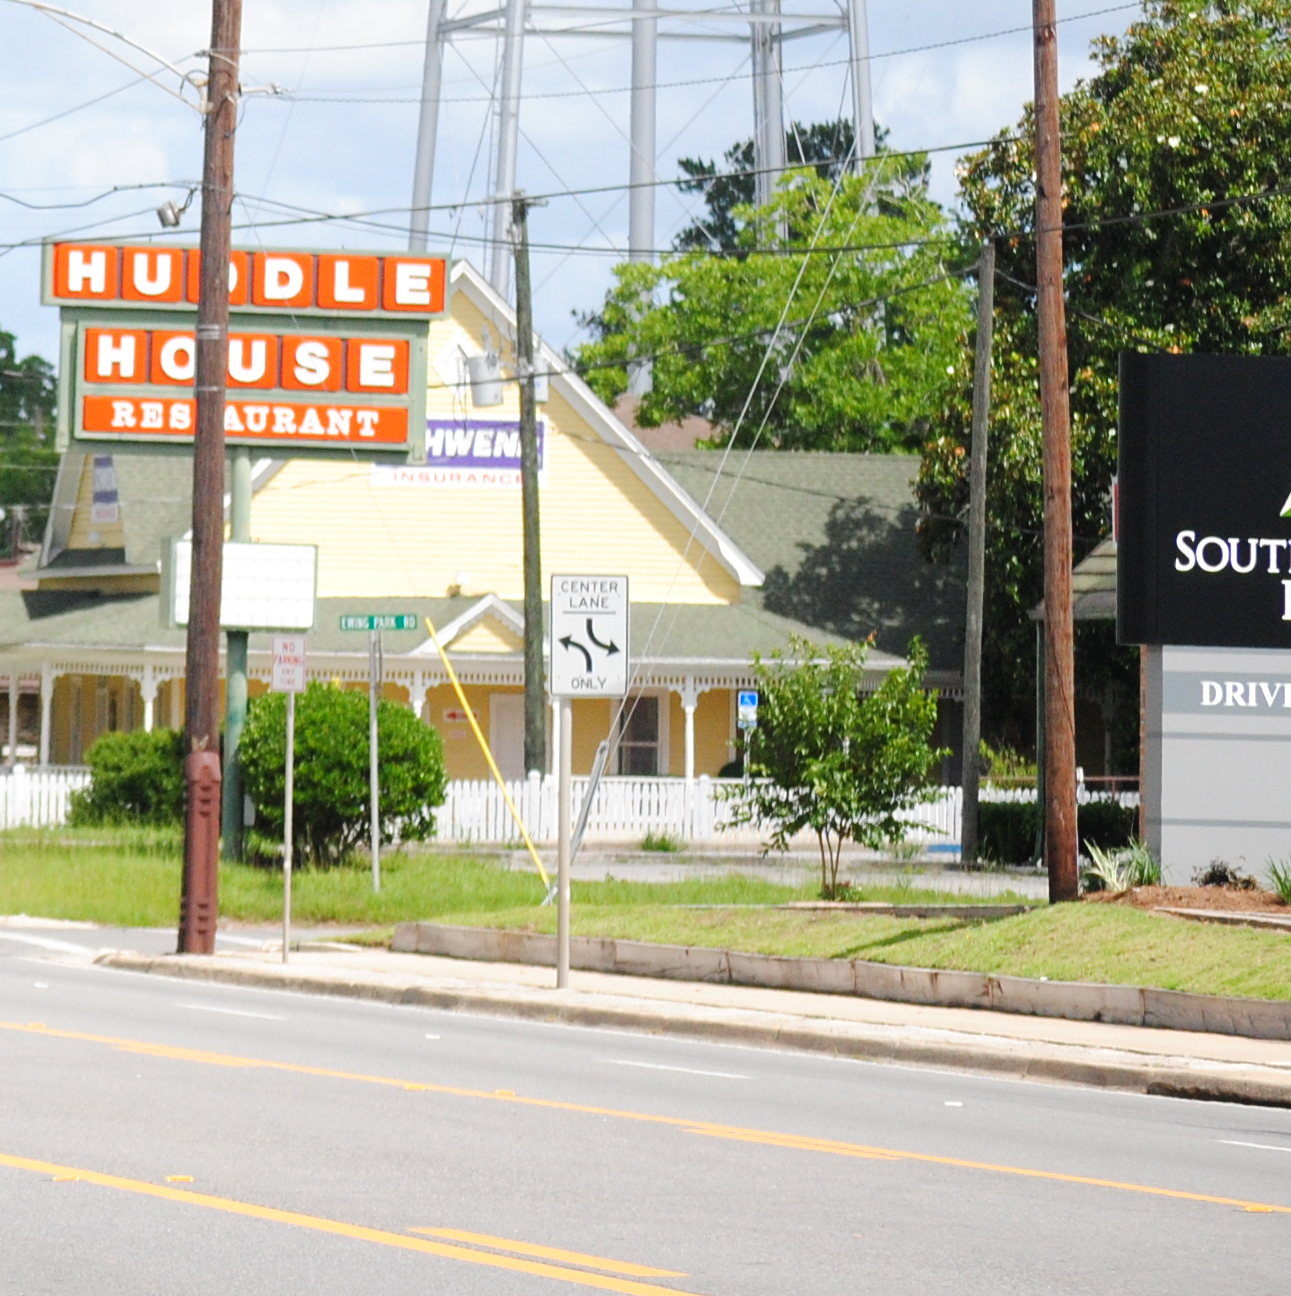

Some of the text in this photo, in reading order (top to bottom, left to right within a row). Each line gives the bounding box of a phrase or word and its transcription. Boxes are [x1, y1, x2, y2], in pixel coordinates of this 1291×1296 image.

[67, 249, 433, 306] HUDLE
[96, 334, 396, 388] HOUSE
[111, 401, 380, 437] RESAURANT
[1174, 530, 1291, 574] SOUT
[560, 581, 619, 593] CENTER
[569, 597, 609, 609] LANE
[341, 617, 416, 629] EWING PARK RD
[282, 642, 296, 653] NO
[571, 678, 607, 690] ONLY
